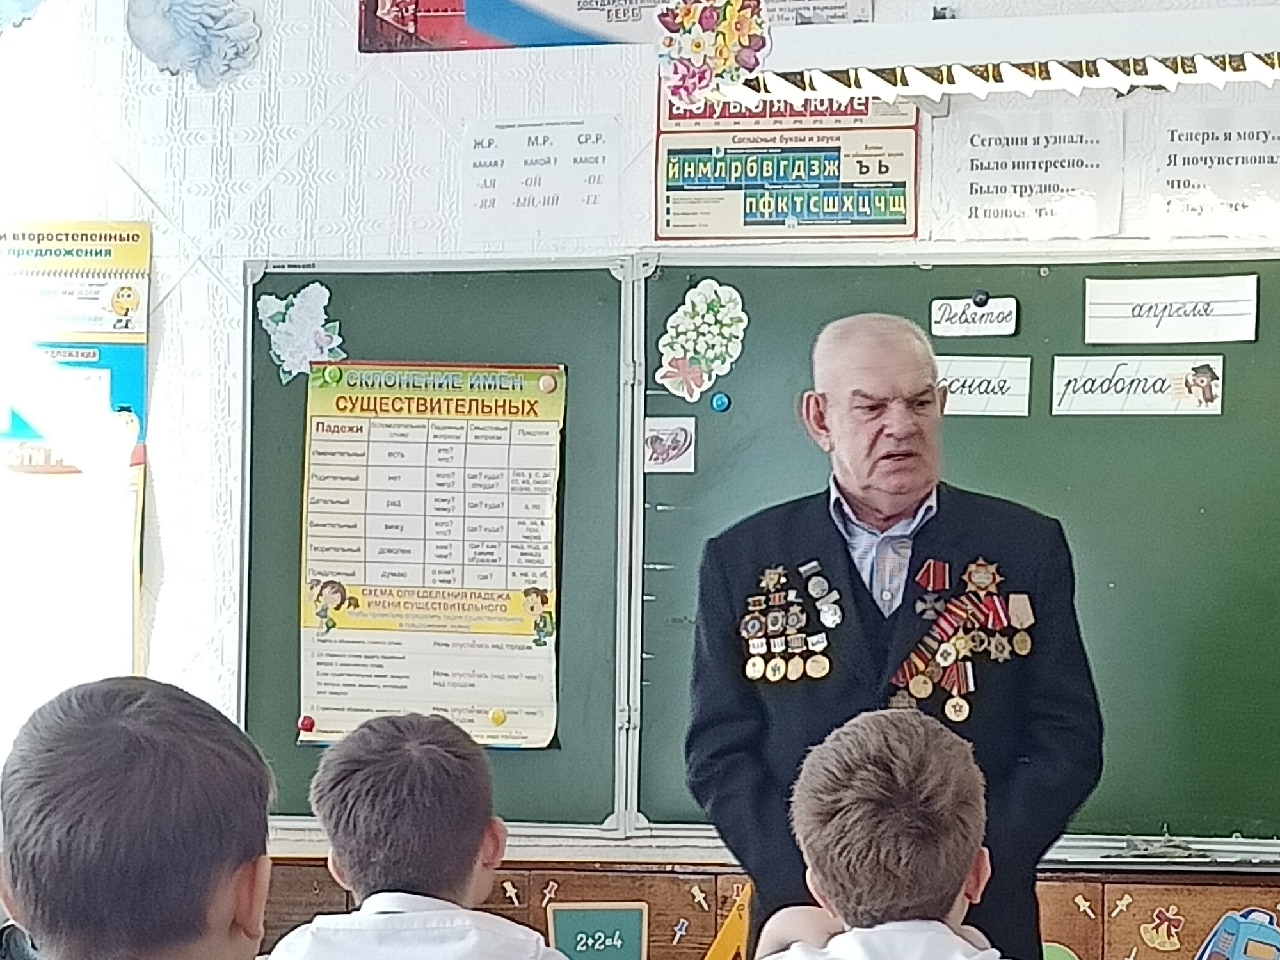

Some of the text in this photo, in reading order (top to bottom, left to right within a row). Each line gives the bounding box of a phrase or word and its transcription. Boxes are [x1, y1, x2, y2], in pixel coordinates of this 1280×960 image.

[473, 133, 606, 150] Ж.Р. М.Р. СР.Р.
[732, 135, 776, 144] Согласные
[779, 134, 807, 144] буквы
[816, 134, 841, 143] звуки
[969, 134, 1028, 148] Сегодня
[1032, 136, 1041, 145] я
[1167, 129, 1220, 145] Теперь
[1223, 131, 1232, 141] я
[969, 158, 1008, 171] Было
[1166, 153, 1178, 166] Я
[969, 182, 1007, 195] Было
[12, 233, 141, 244] второстепенные
[7, 248, 112, 258] предложения
[933, 301, 1214, 328] Девятое апреля
[346, 371, 463, 391] СКЛОНЕНИЕ
[1057, 362, 1171, 407] работа
[335, 395, 539, 417] СУЩЕСТВИТЕЛЬНЫХ
[316, 422, 363, 435] Падежи
[362, 588, 512, 601] СХЕМА ОПРЕДЕЛЕНИЯ ПАДЕЖА
[367, 600, 508, 613] ИМЕНИ СУЩЕСТВИТЕЛЬНОГО
[576, 930, 623, 950] 2+2=4
